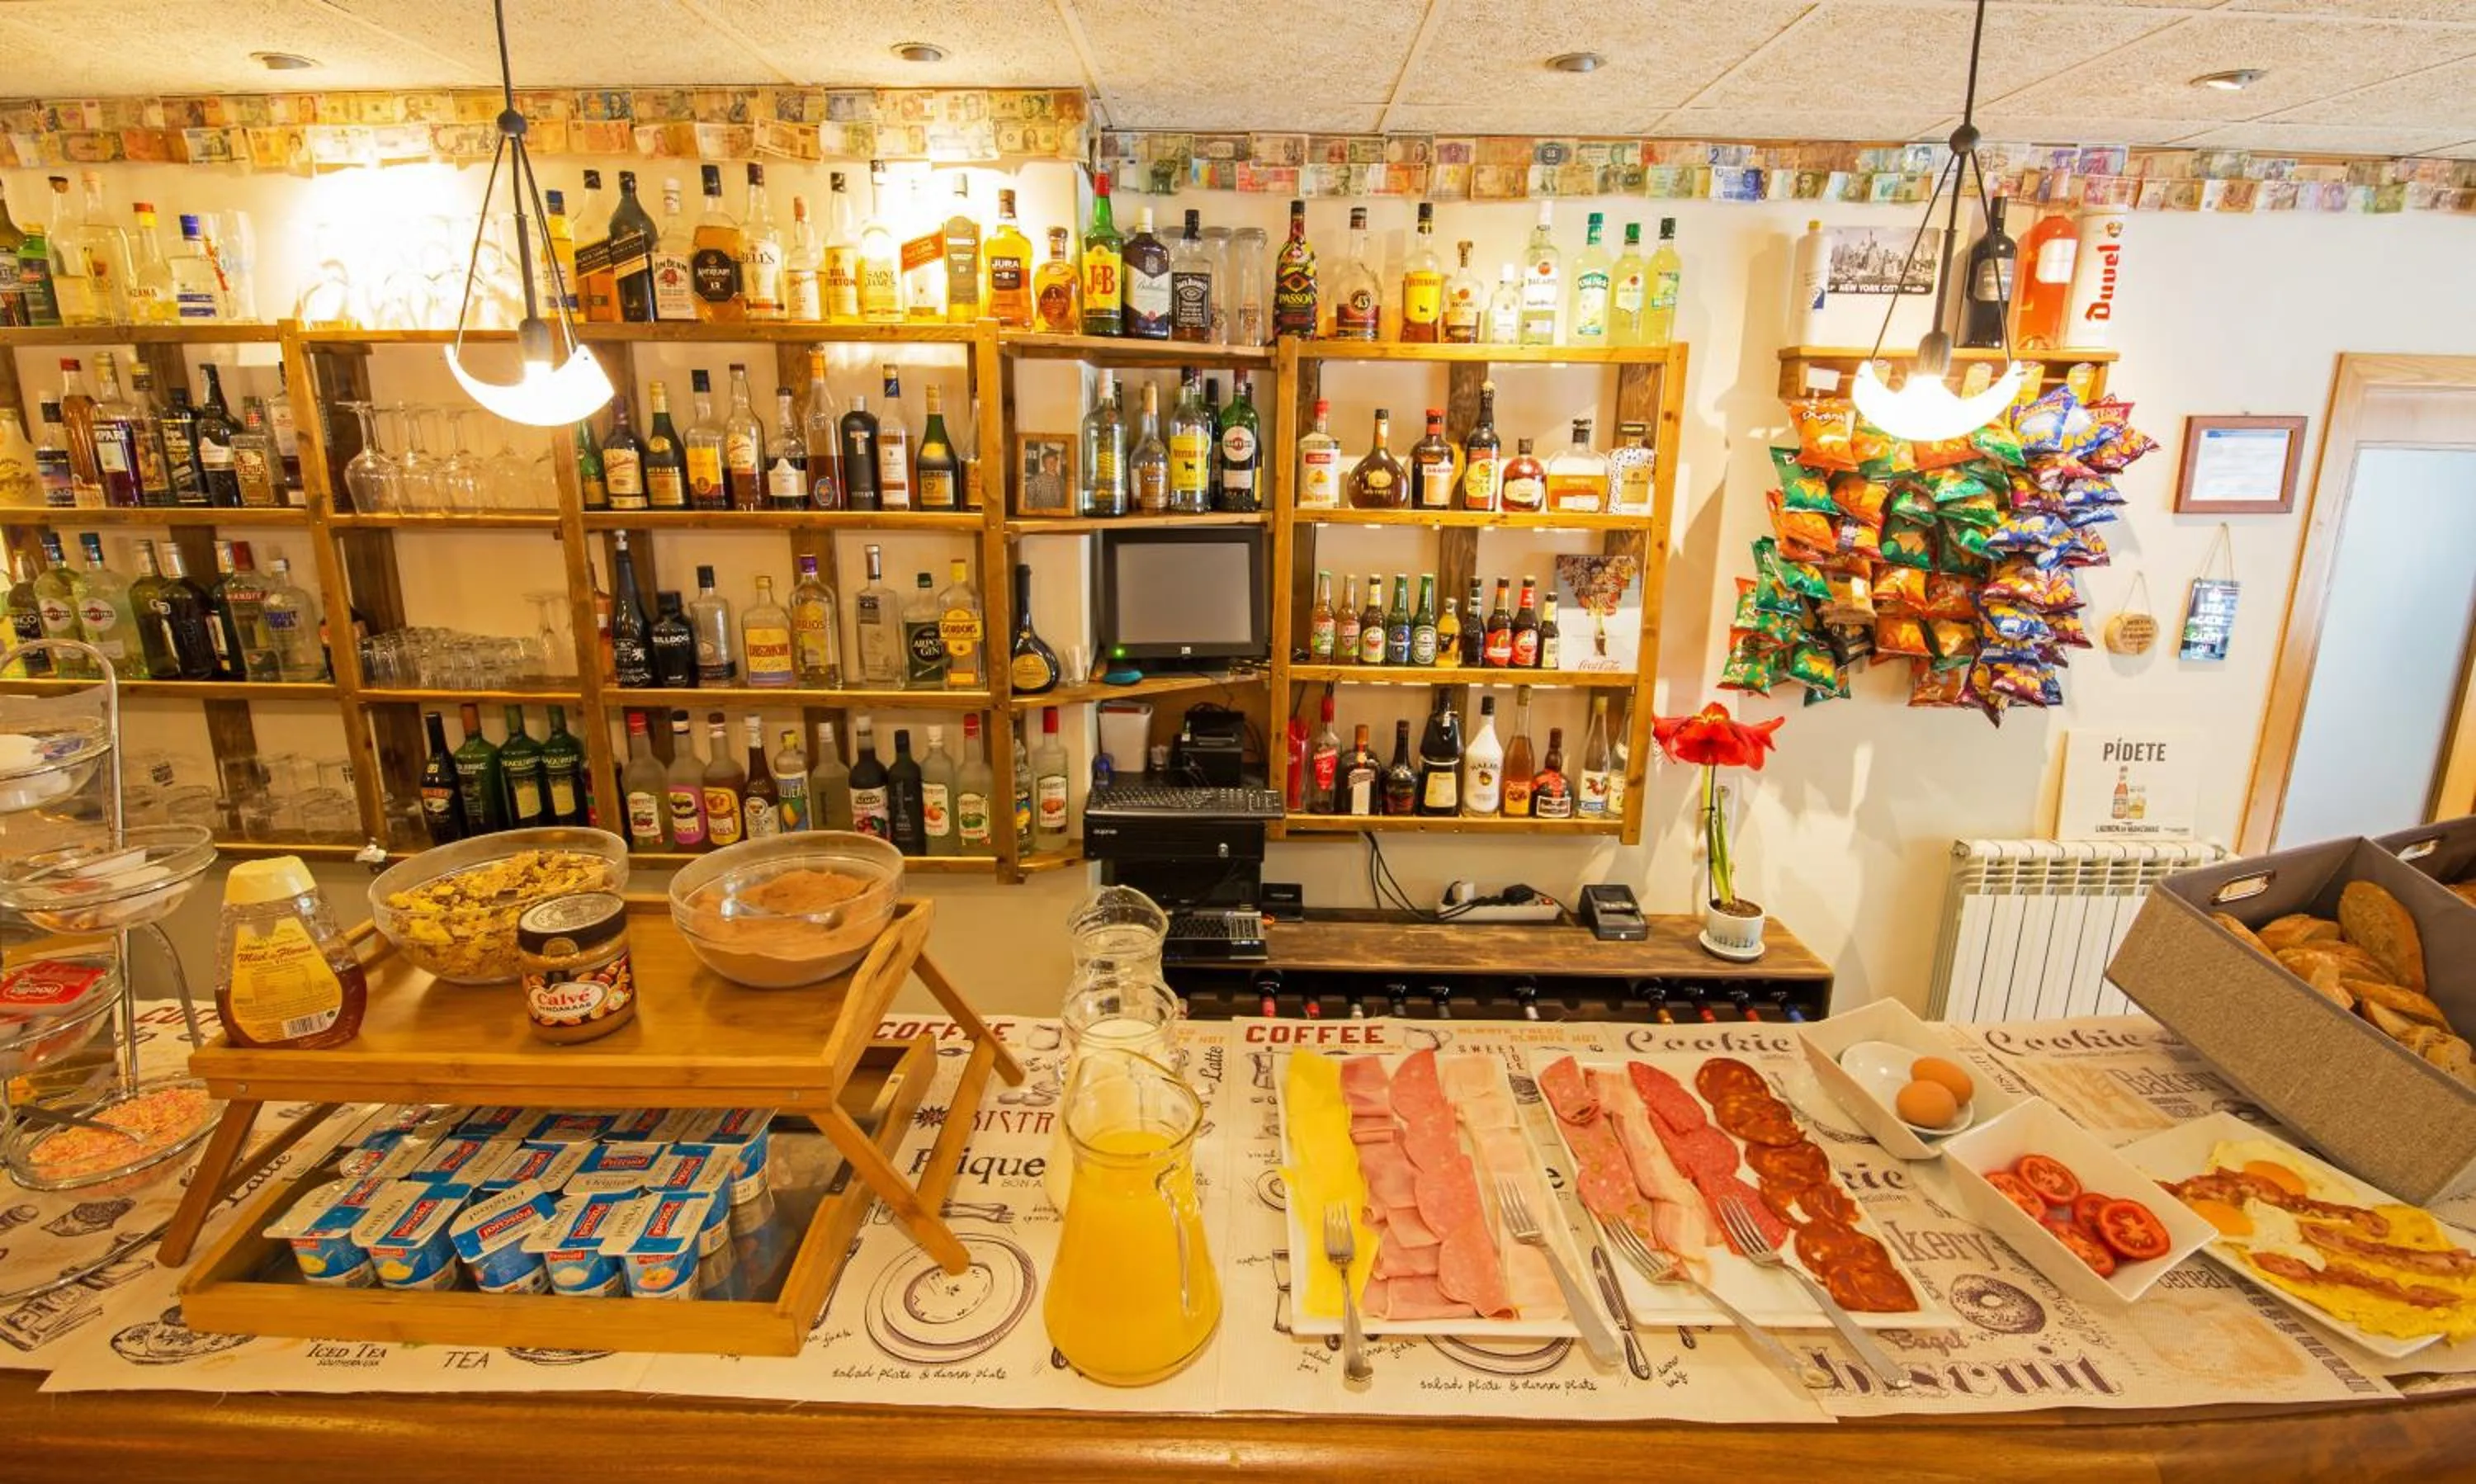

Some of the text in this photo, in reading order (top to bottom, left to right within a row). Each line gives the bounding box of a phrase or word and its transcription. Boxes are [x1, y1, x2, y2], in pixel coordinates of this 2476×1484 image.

[991, 259, 1019, 269] JURA
[1838, 283, 1857, 293] NEW
[1858, 283, 1880, 293] YORK
[2085, 244, 2122, 323] Duvel
[2103, 736, 2166, 762] PÍDETE
[538, 986, 590, 1005] Calvé
[1245, 1024, 1385, 1045] COFFEE
[1625, 1029, 1792, 1053] Cookie
[1984, 1028, 2143, 1056] Cookie
[306, 1342, 388, 1359] ICED TEA
[442, 1350, 490, 1369] TEA
